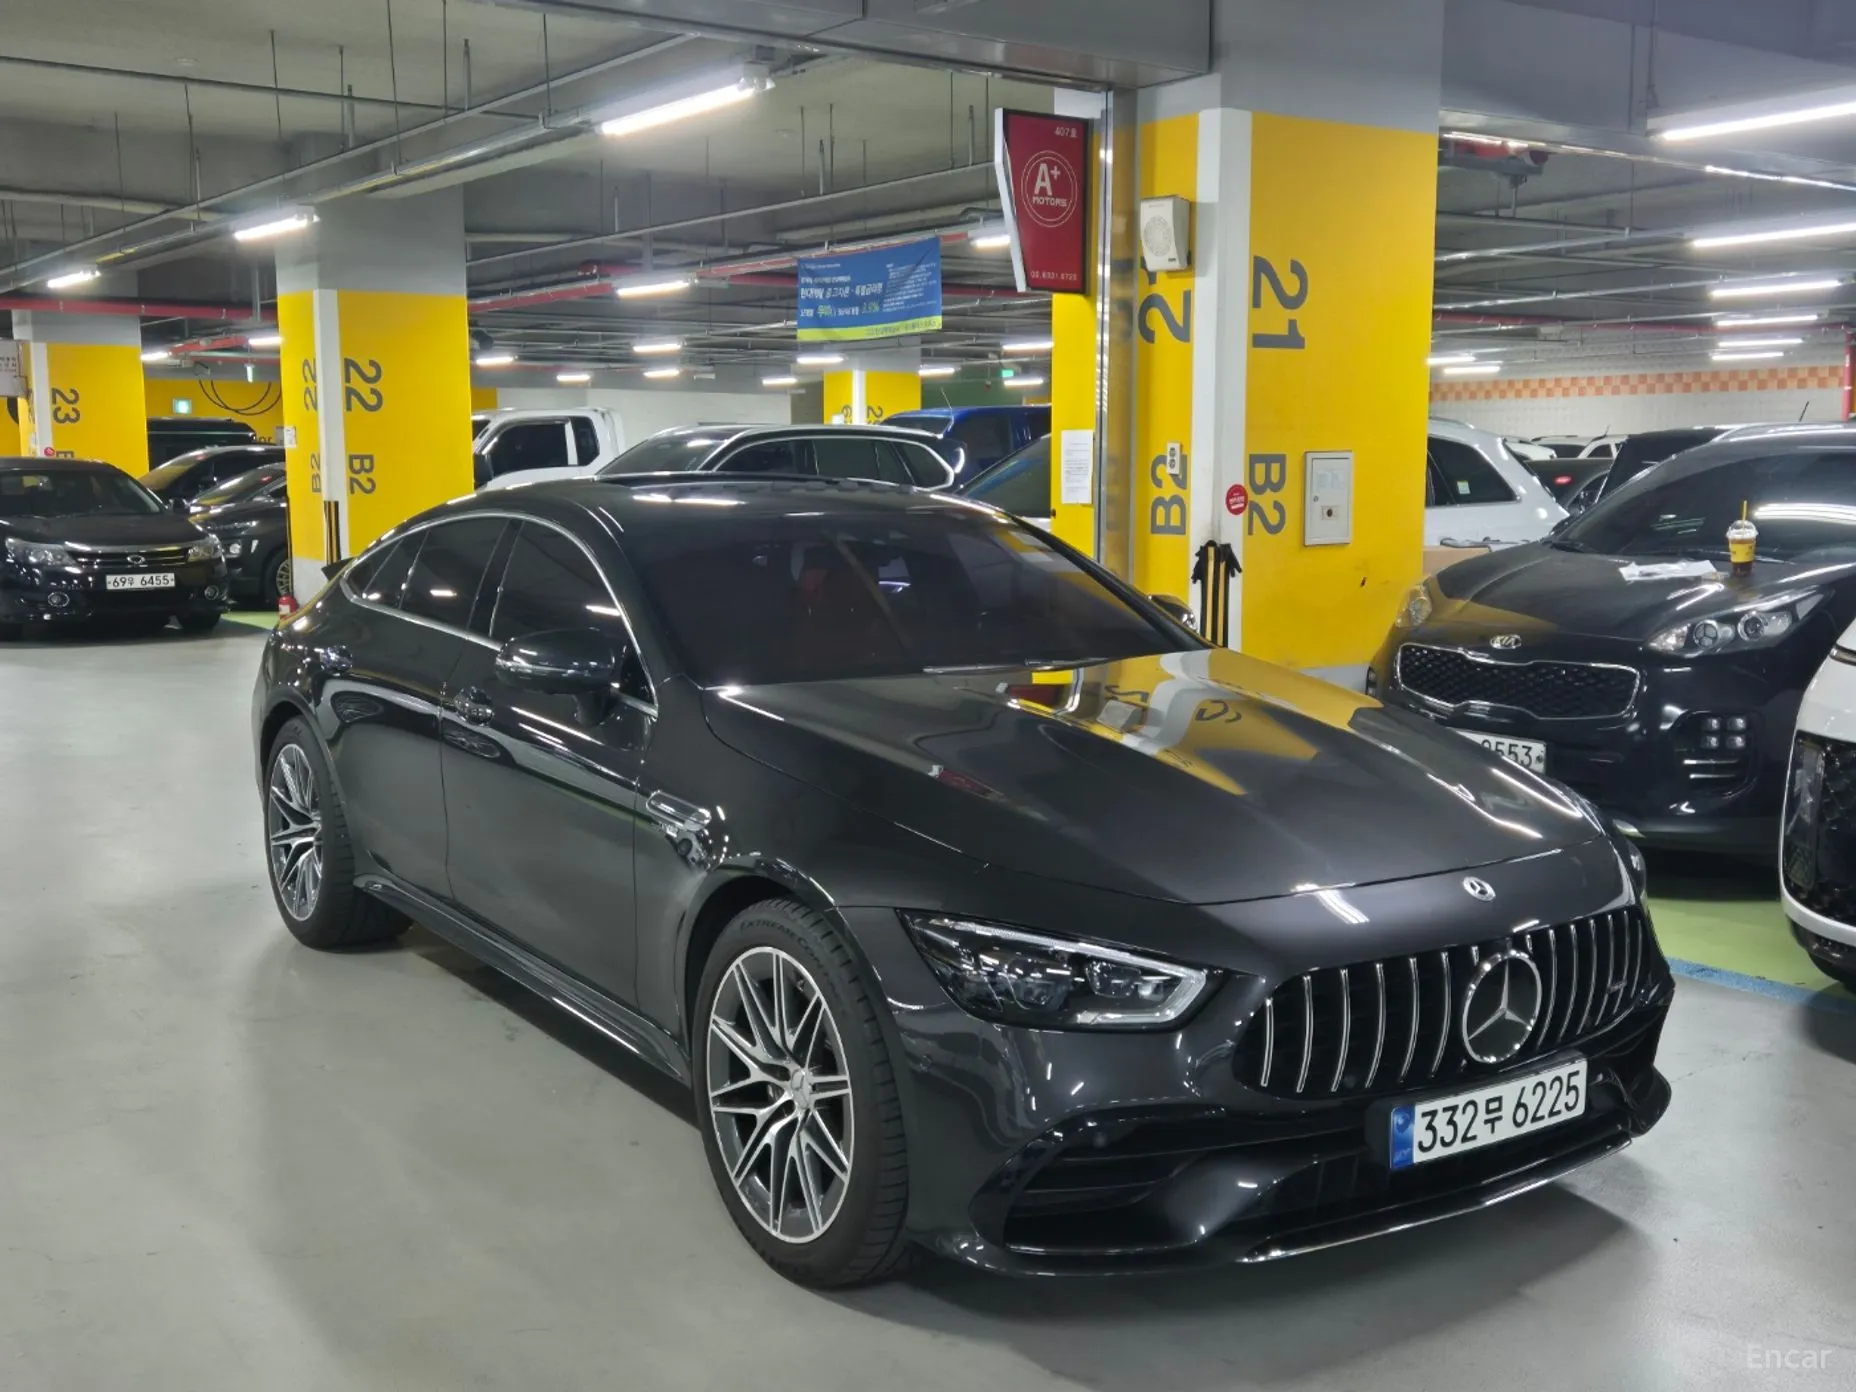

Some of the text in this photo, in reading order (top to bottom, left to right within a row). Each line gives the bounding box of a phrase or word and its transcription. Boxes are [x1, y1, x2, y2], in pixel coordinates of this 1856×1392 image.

[1032, 195, 1068, 207] MOTORS
[1034, 162, 1061, 196] A+
[1252, 255, 1309, 349] 21
[51, 387, 80, 424] 23
[344, 357, 383, 412] 22
[349, 454, 376, 494] B2
[1151, 454, 1187, 535] B2
[1248, 453, 1287, 536] B2
[140, 574, 170, 586] 6455
[1418, 1070, 1580, 1153] 332무 6225
